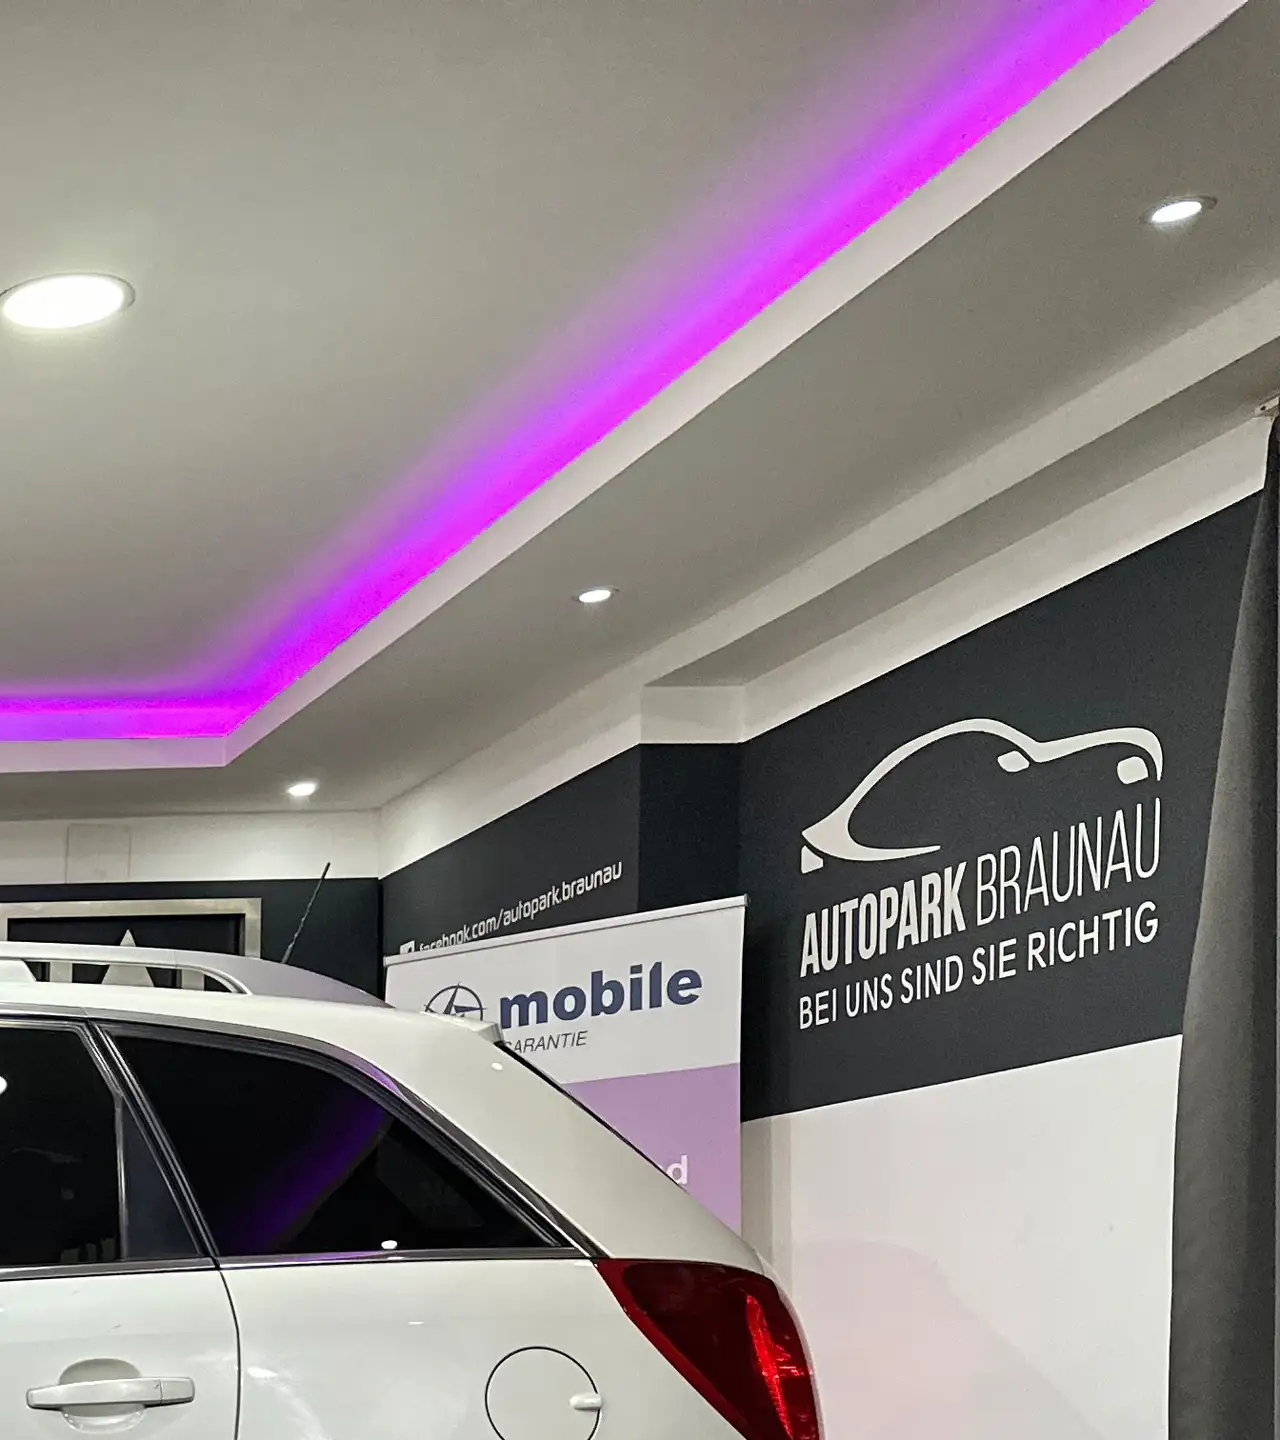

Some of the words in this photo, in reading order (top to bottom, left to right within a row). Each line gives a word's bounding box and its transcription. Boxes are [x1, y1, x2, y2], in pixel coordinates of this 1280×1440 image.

[799, 861, 967, 978] AUTOPARK
[976, 796, 1161, 927] BRAUNAU
[499, 961, 702, 1029] mobile
[799, 989, 837, 1030] BEI
[846, 973, 893, 1018] UNS
[900, 954, 964, 1005] SIND
[972, 938, 1017, 986] SIE
[1027, 900, 1159, 972] RICHTIG
